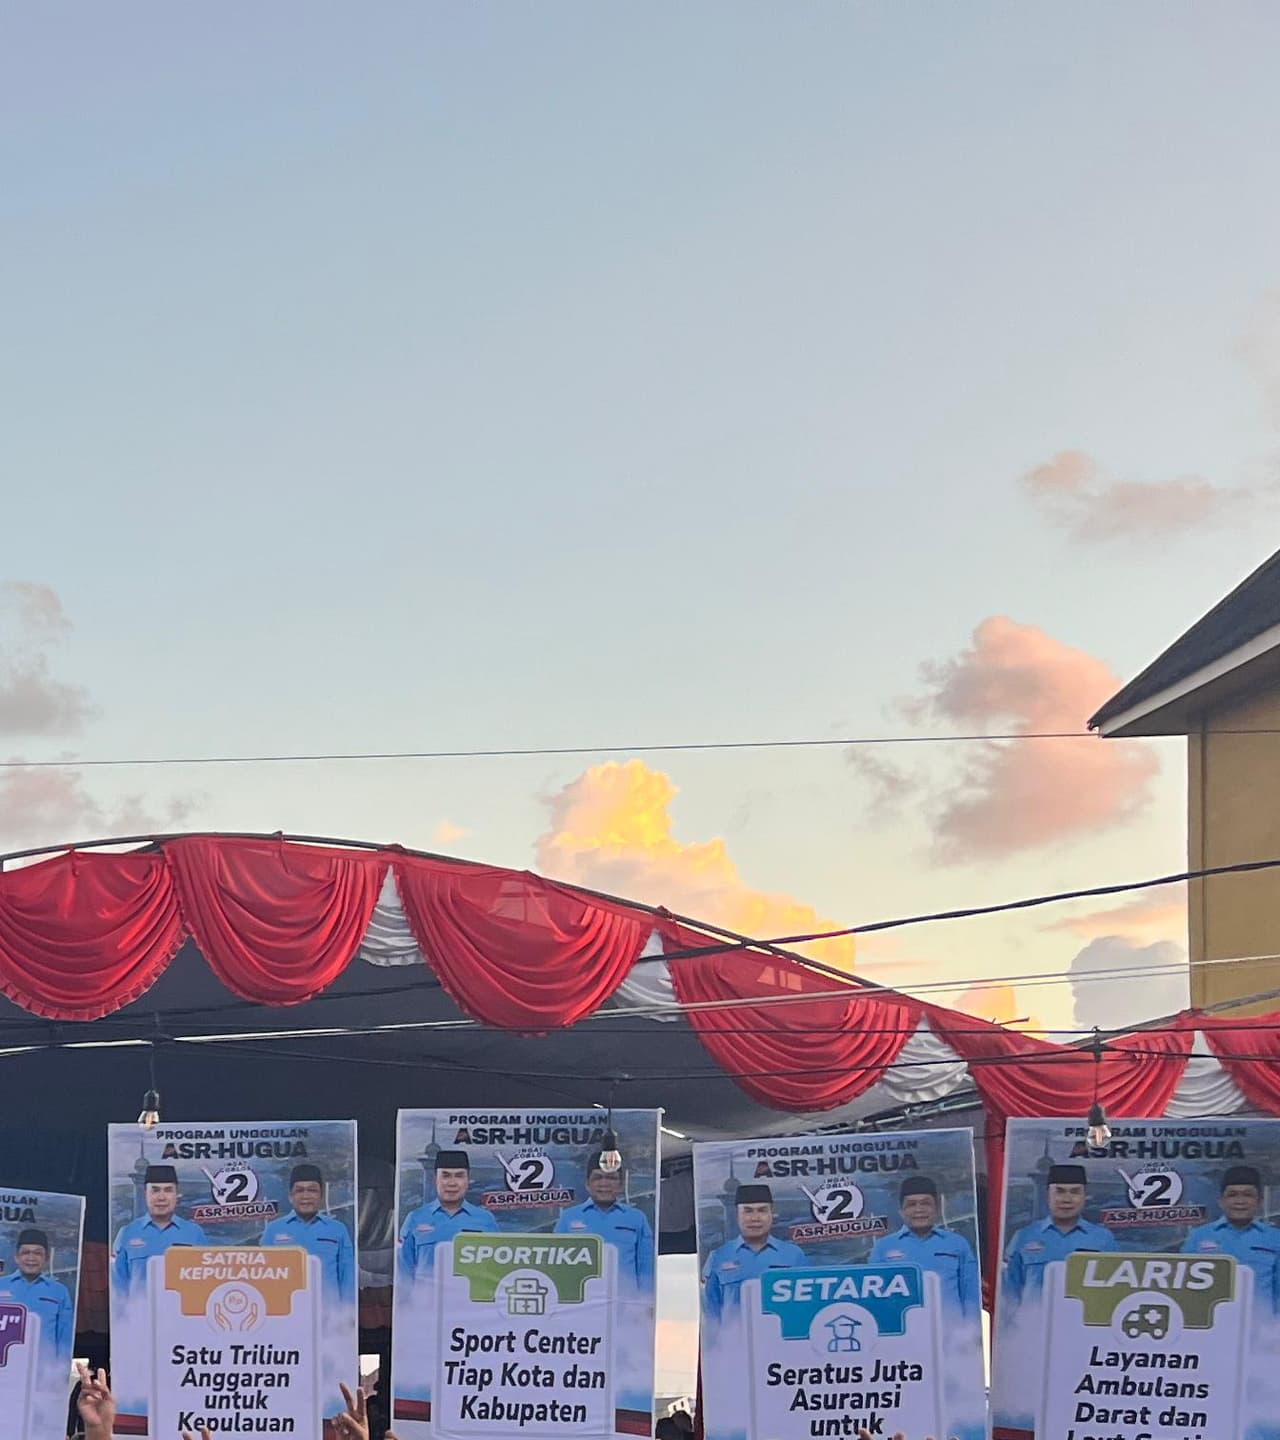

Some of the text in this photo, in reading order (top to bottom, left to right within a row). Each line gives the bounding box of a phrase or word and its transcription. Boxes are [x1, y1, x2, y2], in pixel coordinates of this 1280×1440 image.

[449, 1115, 608, 1125] PROGRAM UNGGULAN
[157, 1128, 309, 1140] PROGRAM UNGGULAN
[454, 1128, 608, 1145] ASR-HUGUA
[1065, 1127, 1246, 1137] PRRAM UNGGULAN
[162, 1141, 308, 1159] ASR-HUGUA
[747, 1140, 919, 1158] PROGRAM UNGGULAN
[1069, 1141, 1245, 1159] ASR-HUGUA
[519, 1160, 544, 1189] 2
[753, 1153, 920, 1178] ASR-HUGUA
[225, 1174, 249, 1203] 2
[488, 1191, 570, 1205] ASR-HUGUA
[1143, 1175, 1172, 1206] 2
[195, 1203, 276, 1218] ASR-HUGUA
[826, 1190, 854, 1221] 2
[1106, 1209, 1201, 1222] ASR-HUGUA
[794, 1220, 883, 1239] ASR-HUGUA
[202, 1252, 266, 1265] SATRIA
[459, 1245, 592, 1266] SPORTIKA
[179, 1267, 289, 1281] KEPULAUAN
[1082, 1260, 1216, 1290] LARIS
[771, 1274, 910, 1302] SETARA
[450, 1327, 601, 1357] Sport Center
[171, 1344, 300, 1366] Satu Triliun
[1089, 1346, 1199, 1371] Layanan
[180, 1367, 290, 1392] Anggaran
[444, 1360, 606, 1391] Tiap Kota dan
[766, 1359, 923, 1386] Seratus Juta
[790, 1384, 902, 1411] Asuransi
[1074, 1374, 1209, 1399] Ambulans
[204, 1390, 269, 1410] untuk
[460, 1395, 587, 1427] Kabupaten
[178, 1412, 295, 1433] Kepulauan
[810, 1412, 885, 1437] untuk
[1075, 1402, 1207, 1428] Darat dan
